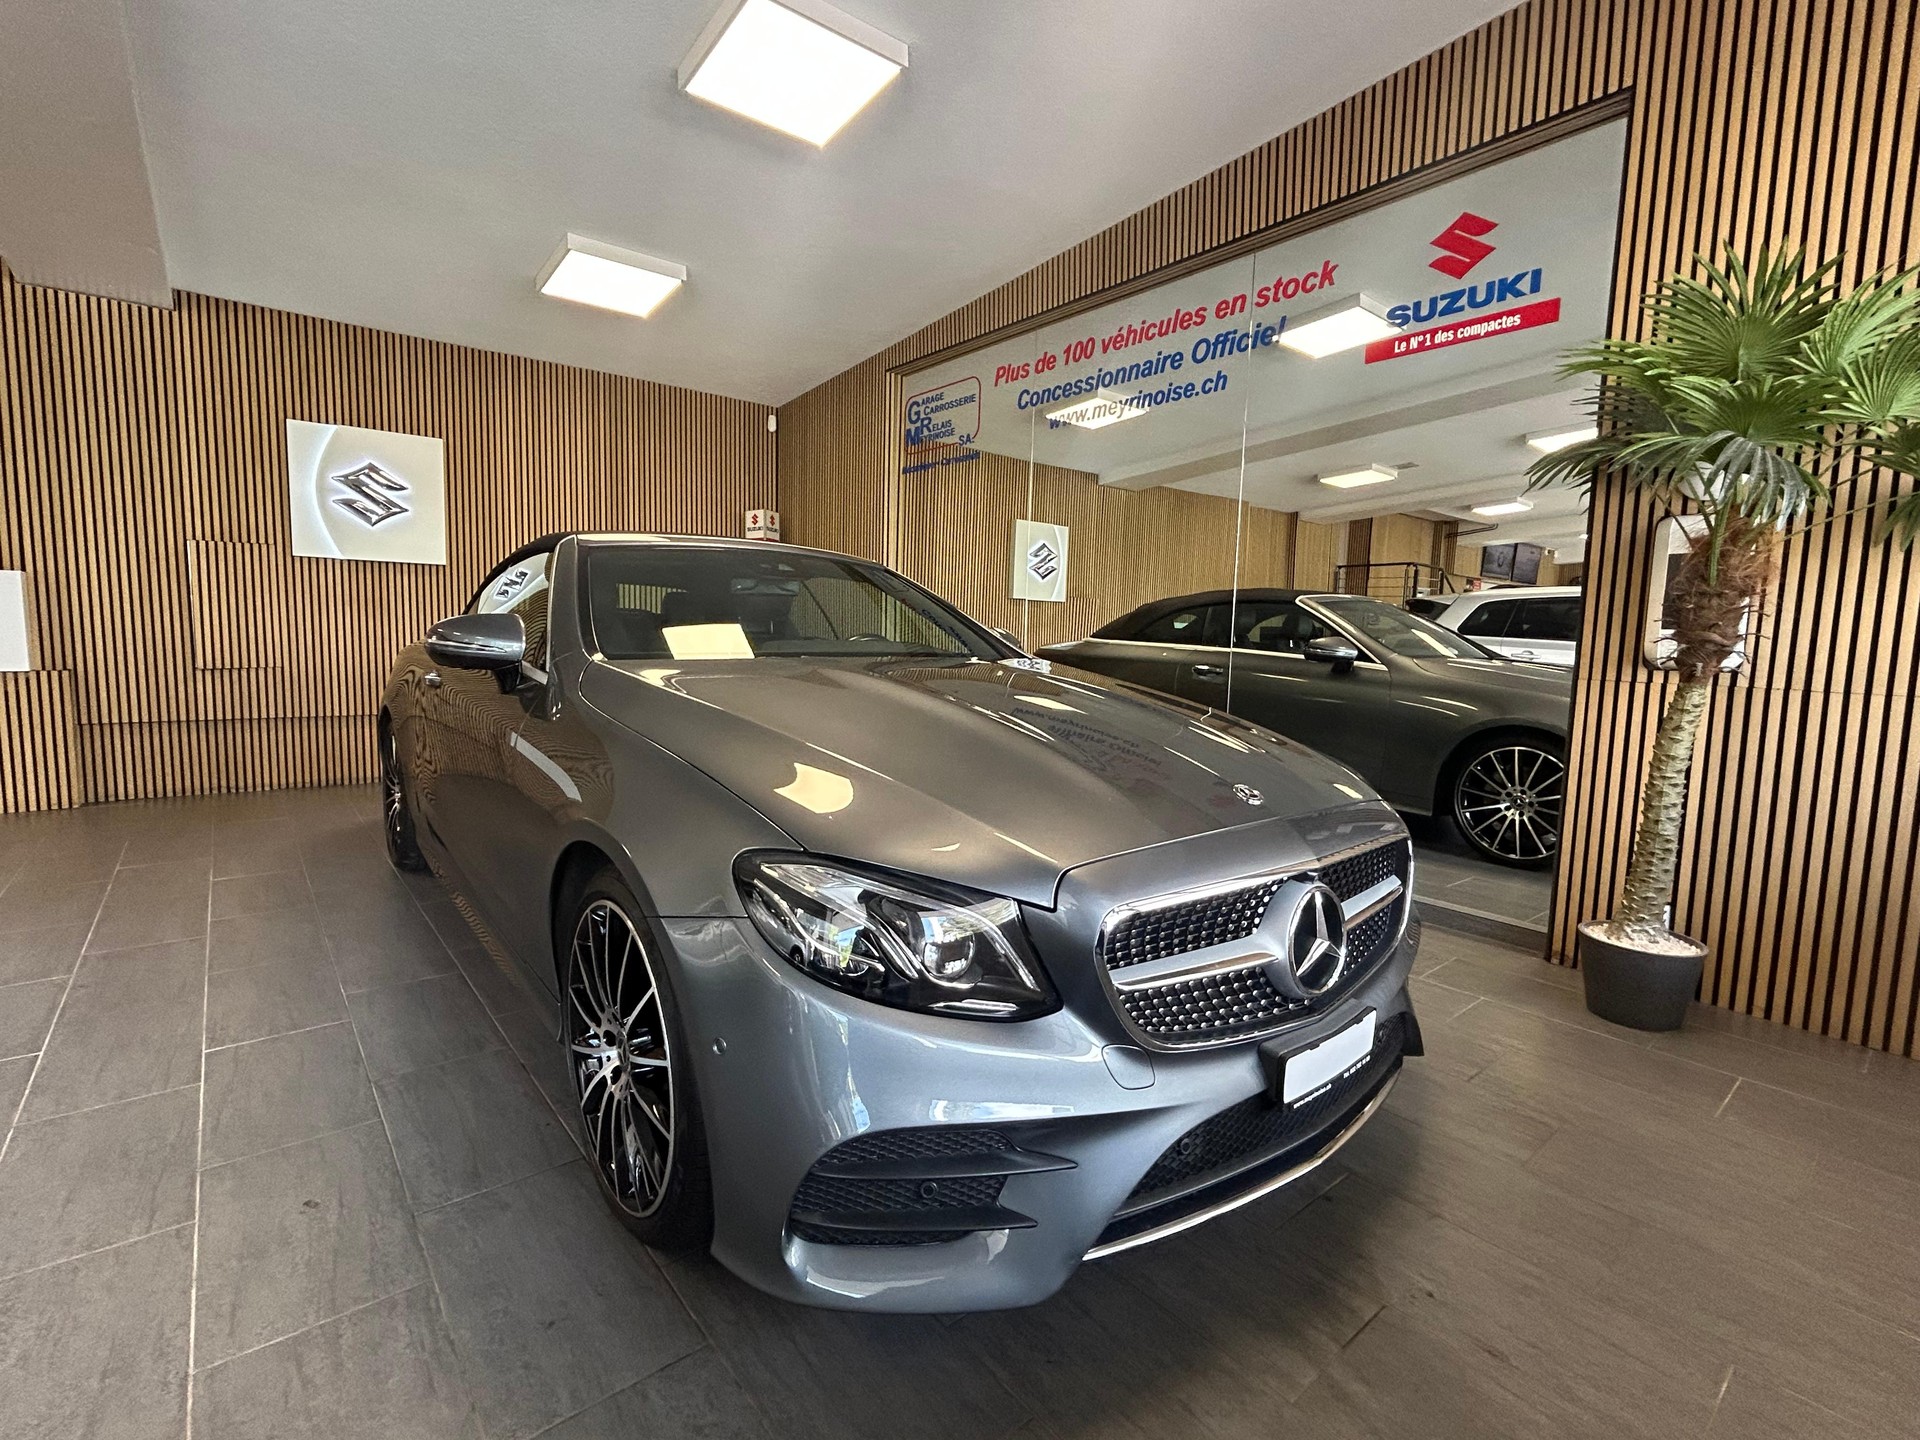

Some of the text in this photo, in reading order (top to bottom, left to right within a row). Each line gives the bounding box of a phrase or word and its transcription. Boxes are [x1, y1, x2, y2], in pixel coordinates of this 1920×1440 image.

[994, 259, 1340, 387] Plus de 100 véhicules en stock
[1386, 267, 1542, 328] SUZUKI
[1017, 316, 1288, 410] Concessionnaire Officiel
[1394, 340, 1407, 353] Le
[1434, 329, 1454, 344] des
[1457, 314, 1521, 339] compactes
[924, 394, 976, 416] CARROSSERIE
[1049, 370, 1228, 430] www.meyrinoise.ch
